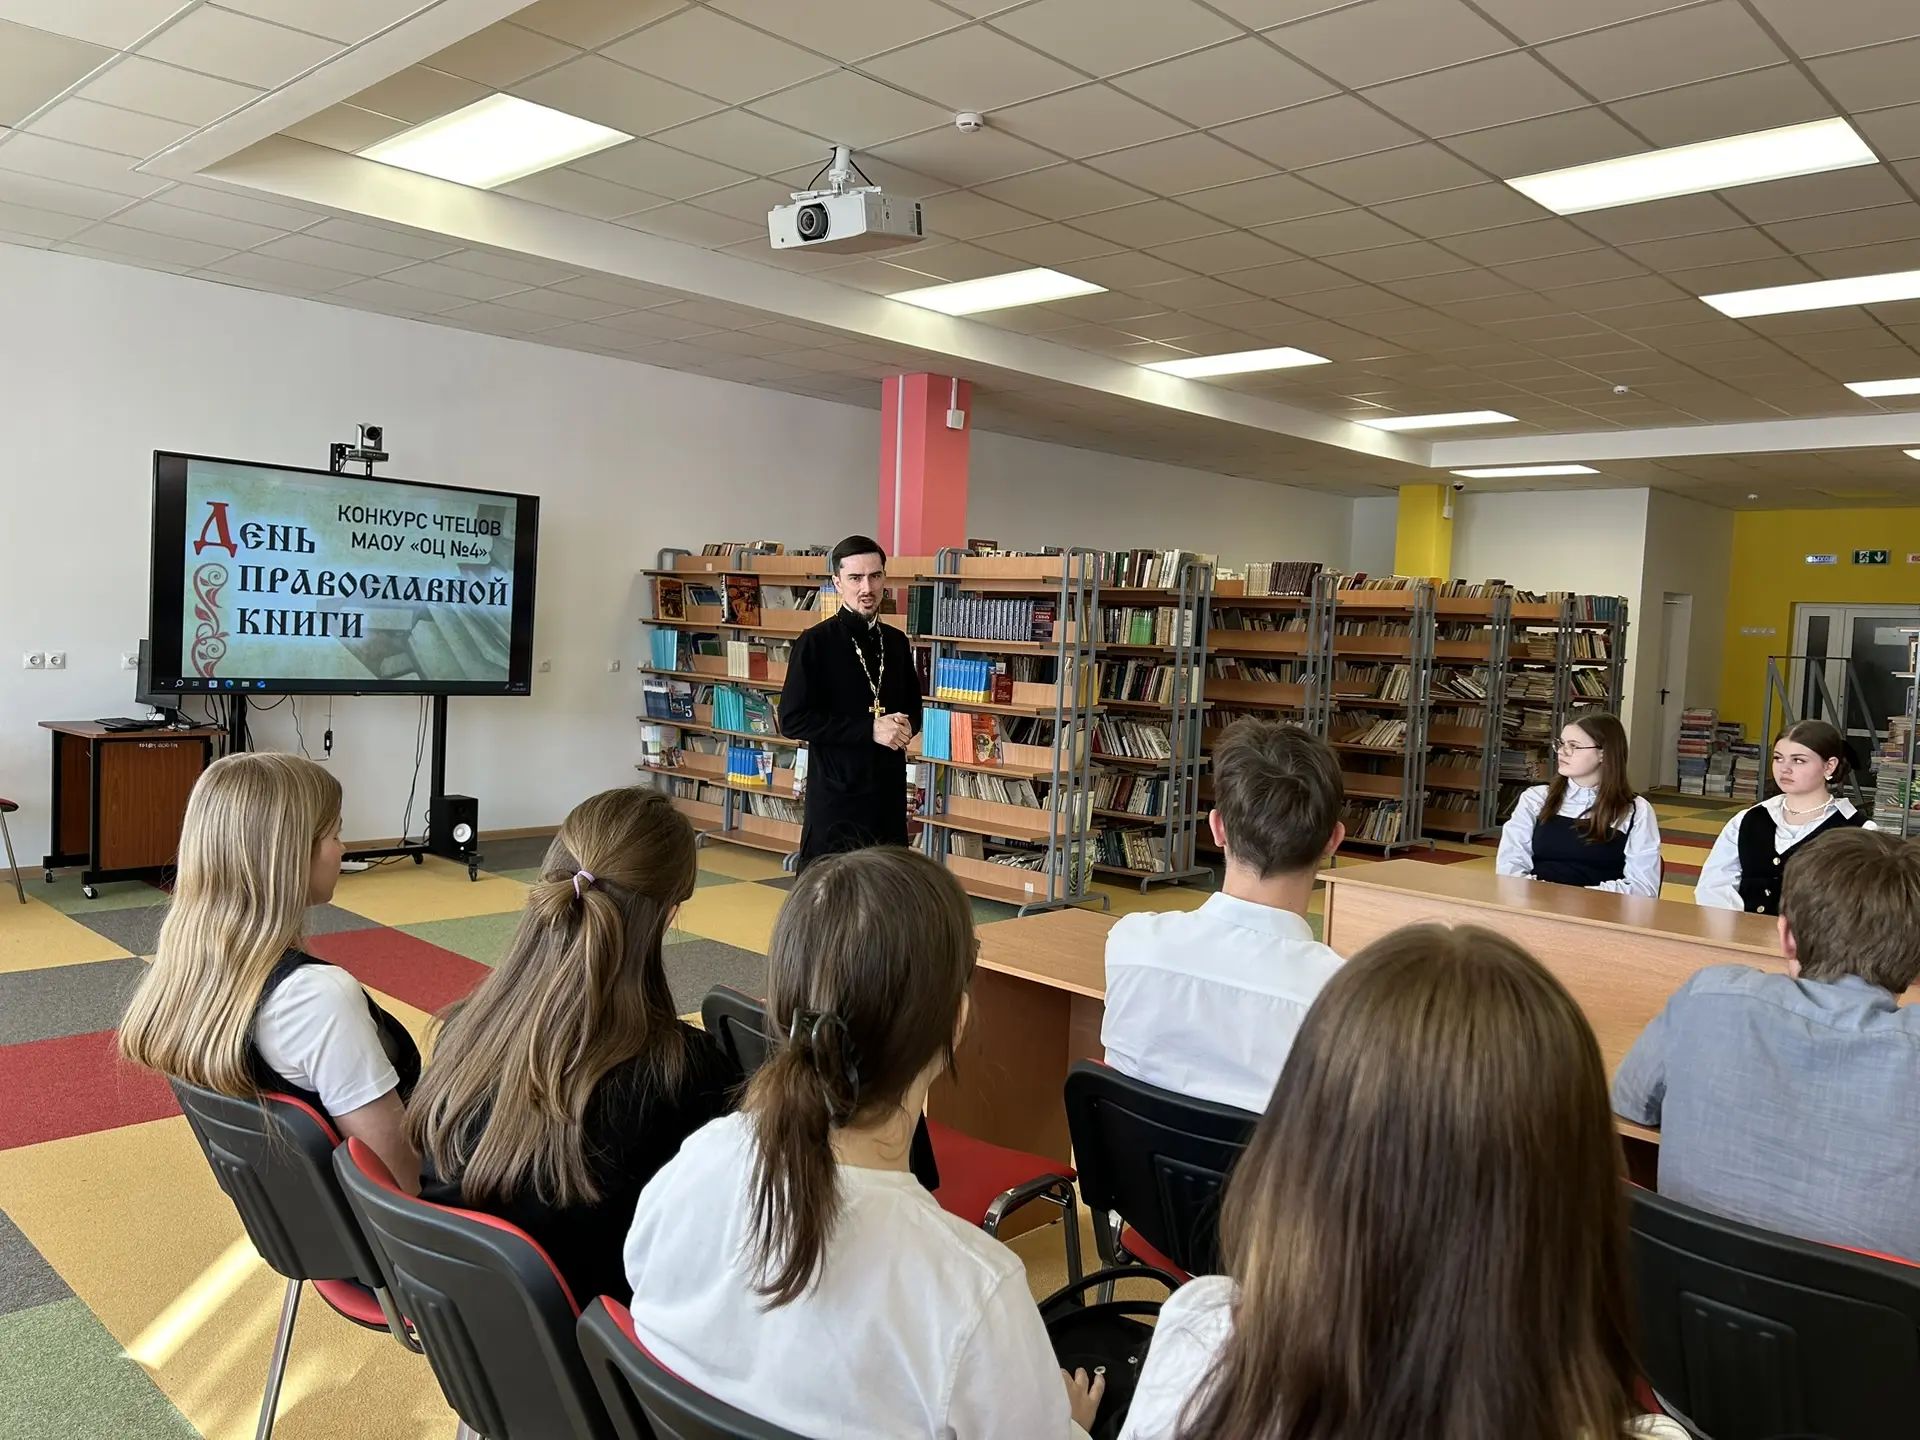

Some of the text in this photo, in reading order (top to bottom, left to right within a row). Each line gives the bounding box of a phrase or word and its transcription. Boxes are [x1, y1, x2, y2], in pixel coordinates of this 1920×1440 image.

[338, 504, 501, 537] КОНКУРС ЧТЕЦОВ
[351, 531, 488, 559] МАОУ «ОЦ №4»
[238, 565, 508, 606] ПРАВОСЛАВНОЙ
[236, 607, 365, 638] КНИГИ
[685, 705, 693, 718] 5
